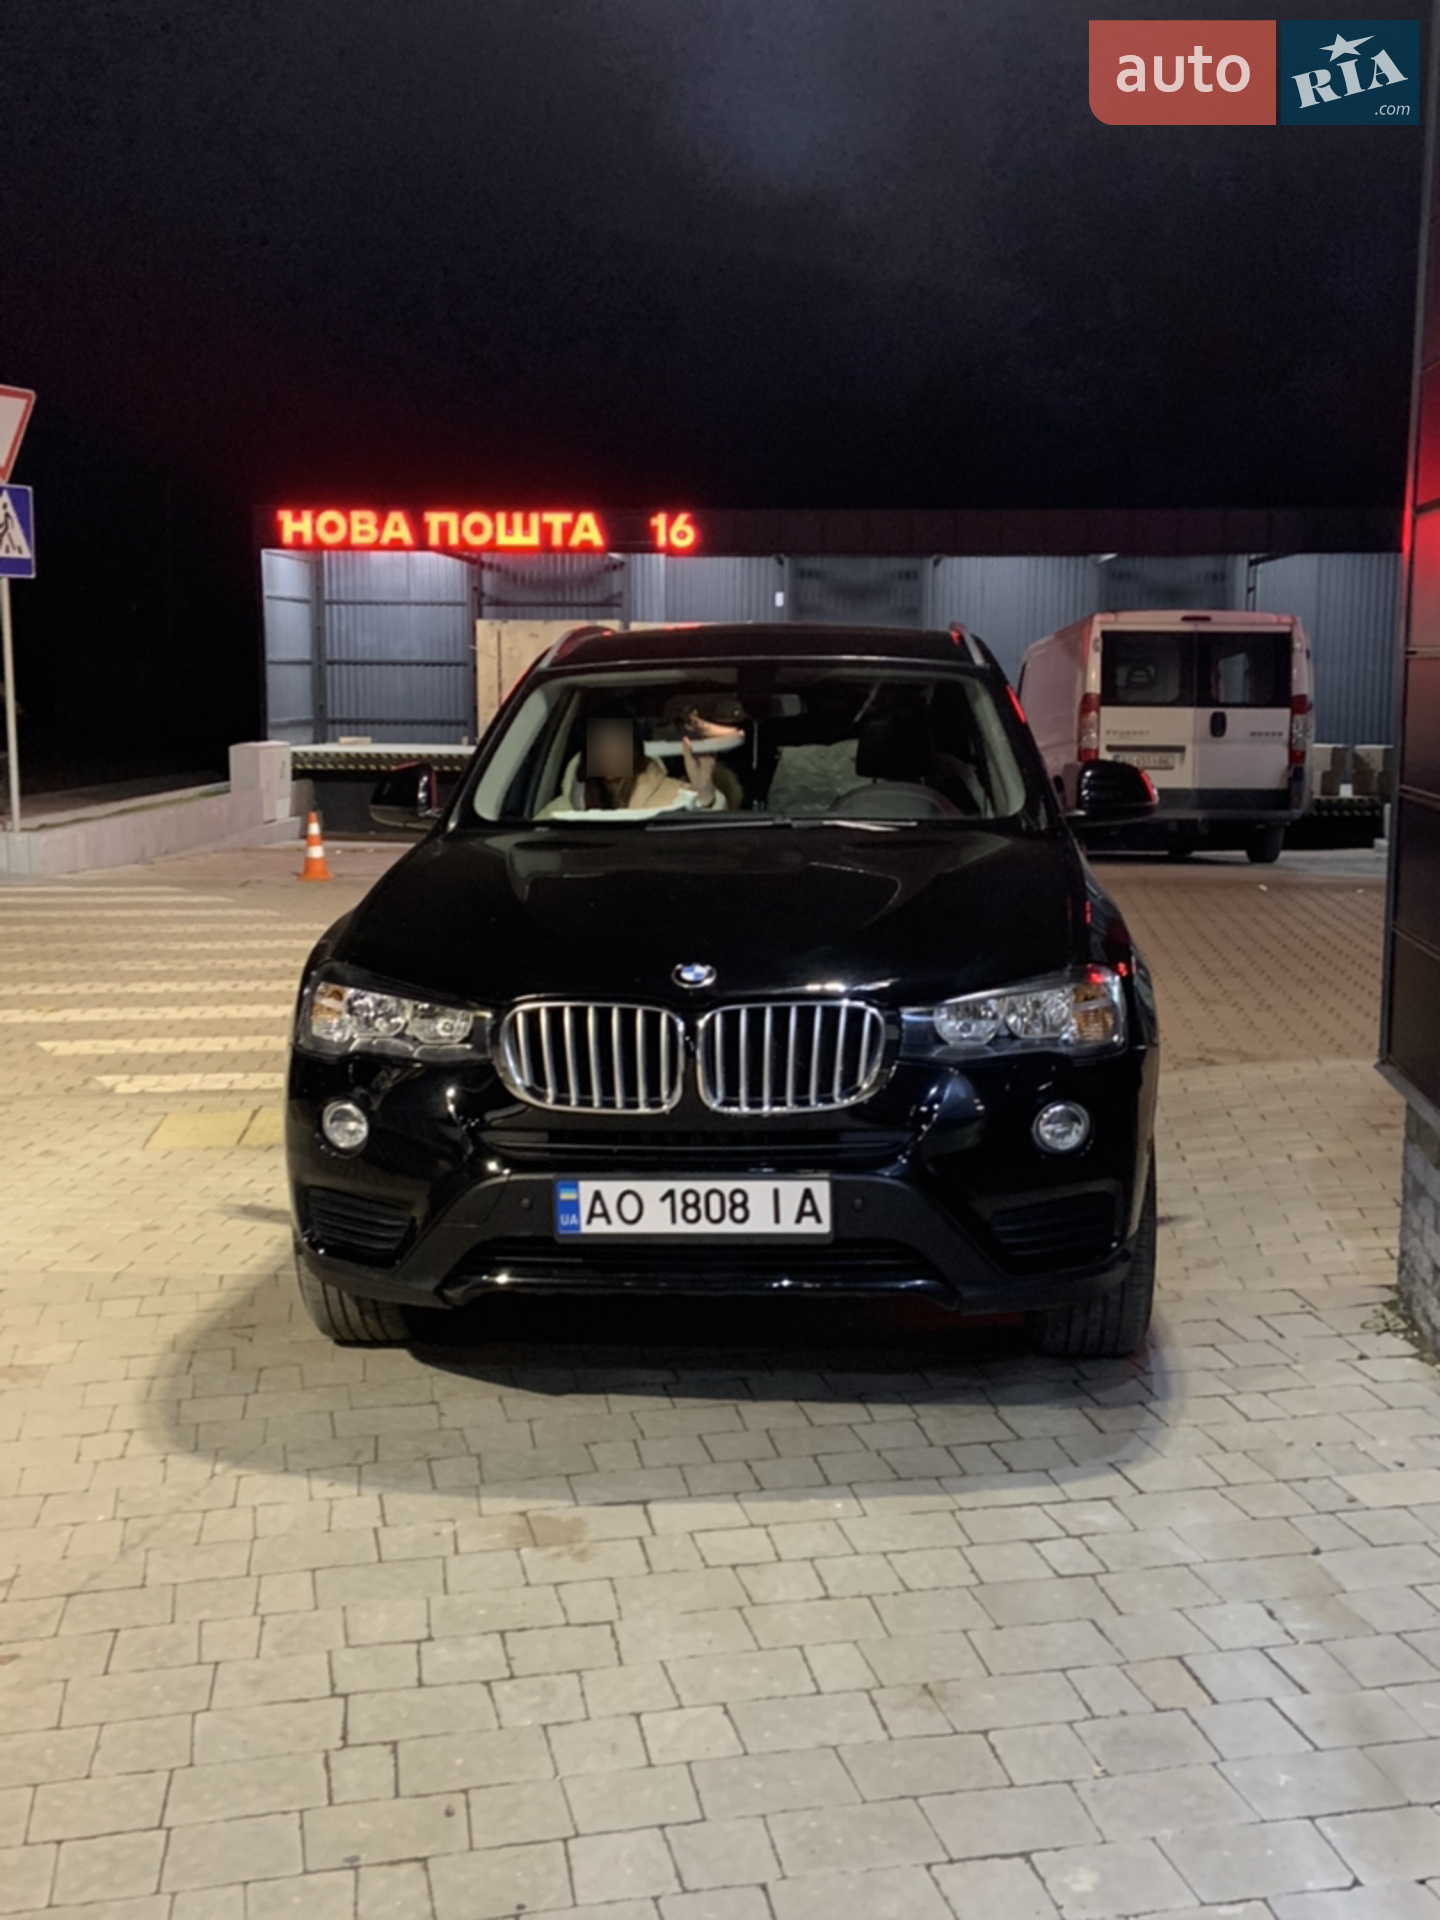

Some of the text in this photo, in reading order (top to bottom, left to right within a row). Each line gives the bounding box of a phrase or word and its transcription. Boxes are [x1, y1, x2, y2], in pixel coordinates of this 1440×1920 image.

[277, 509, 696, 548] НОВА ПОШТА 16
[560, 1213, 579, 1226] UA
[586, 1187, 823, 1226] AO 1808 IA
